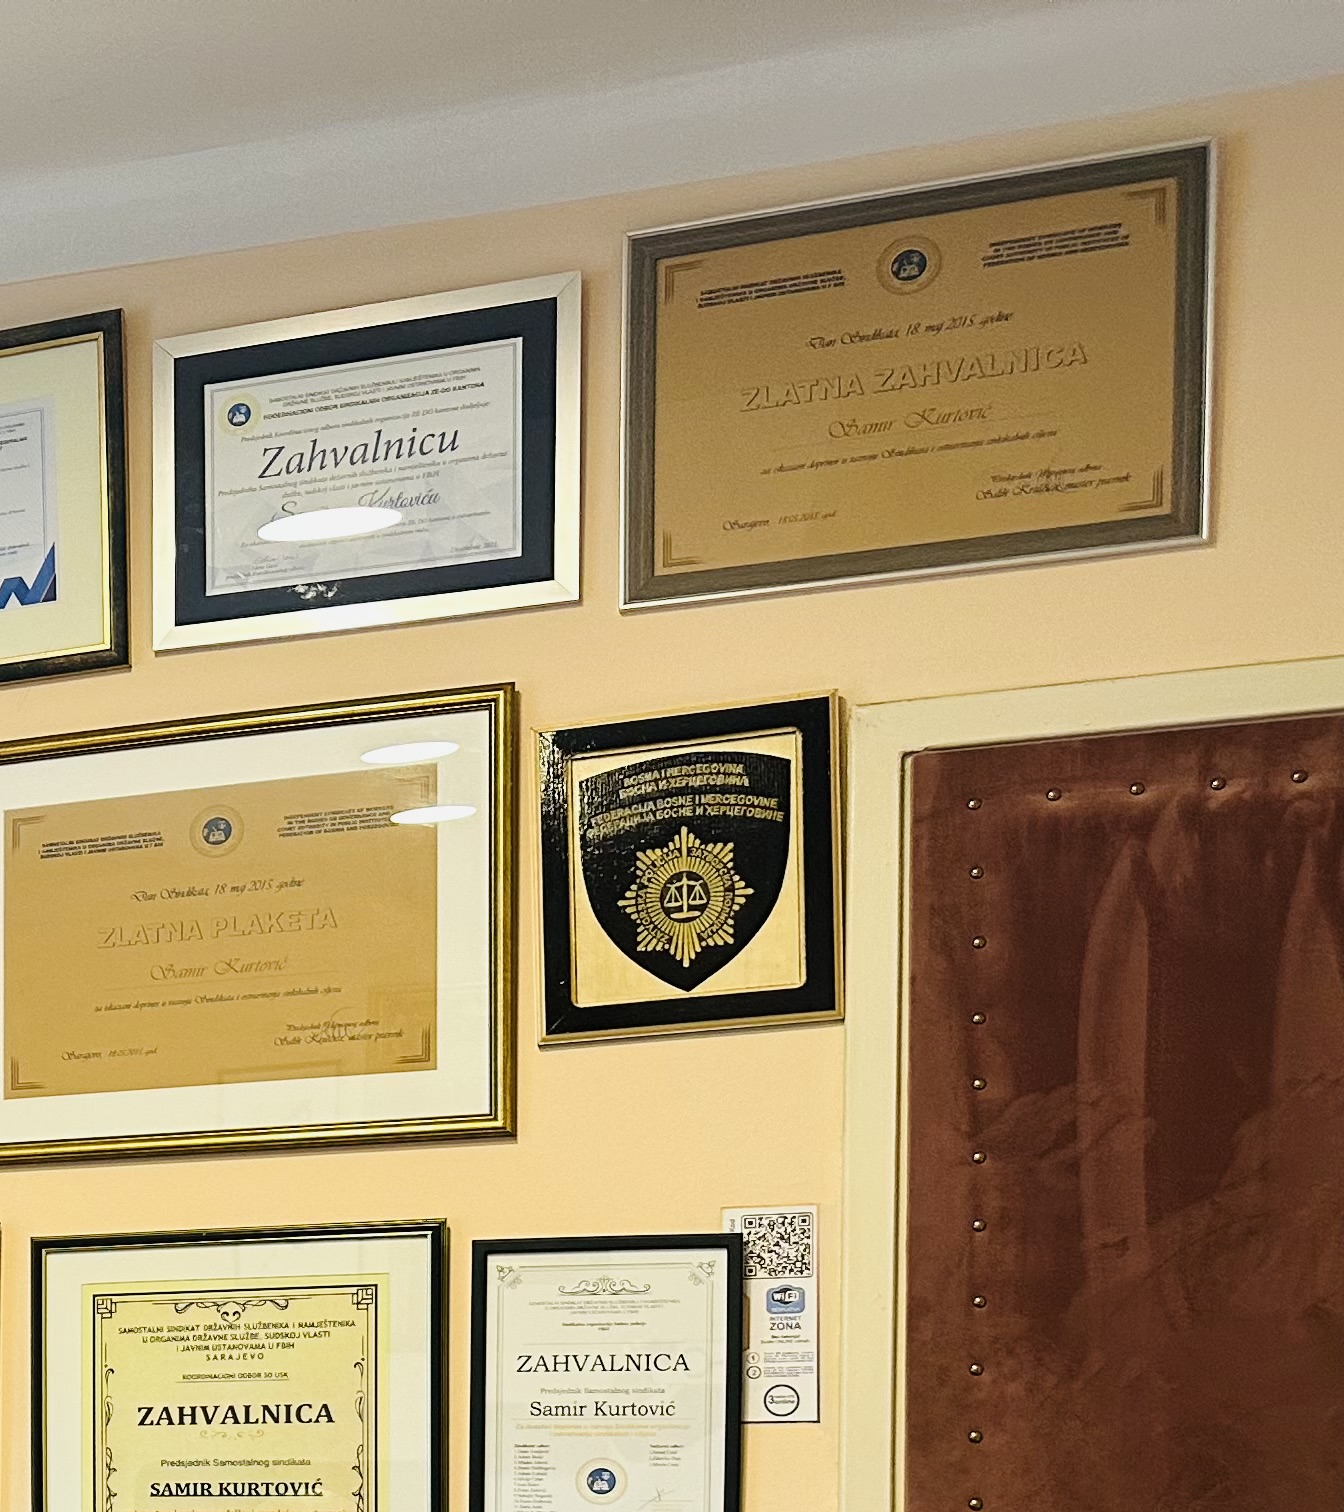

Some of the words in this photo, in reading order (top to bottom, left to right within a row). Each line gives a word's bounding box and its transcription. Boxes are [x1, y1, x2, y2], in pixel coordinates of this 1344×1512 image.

[740, 372, 865, 412] ZLATNA
[873, 341, 1088, 393] ZAHVALNICA
[258, 427, 459, 479] Zahvalnicu
[97, 917, 204, 950] ZLATNA
[211, 906, 338, 940] PLAKETA
[769, 1322, 802, 1331] ZONA
[206, 1353, 264, 1361] SARAJEVO
[516, 1353, 691, 1373] ZAHVALNICA
[137, 1403, 335, 1427] ZAHVALNICA
[530, 1401, 587, 1417] Samir
[594, 1400, 676, 1417] Kurtović
[150, 1482, 213, 1496] SAMIR
[218, 1478, 323, 1496] KURTOVIĆ
